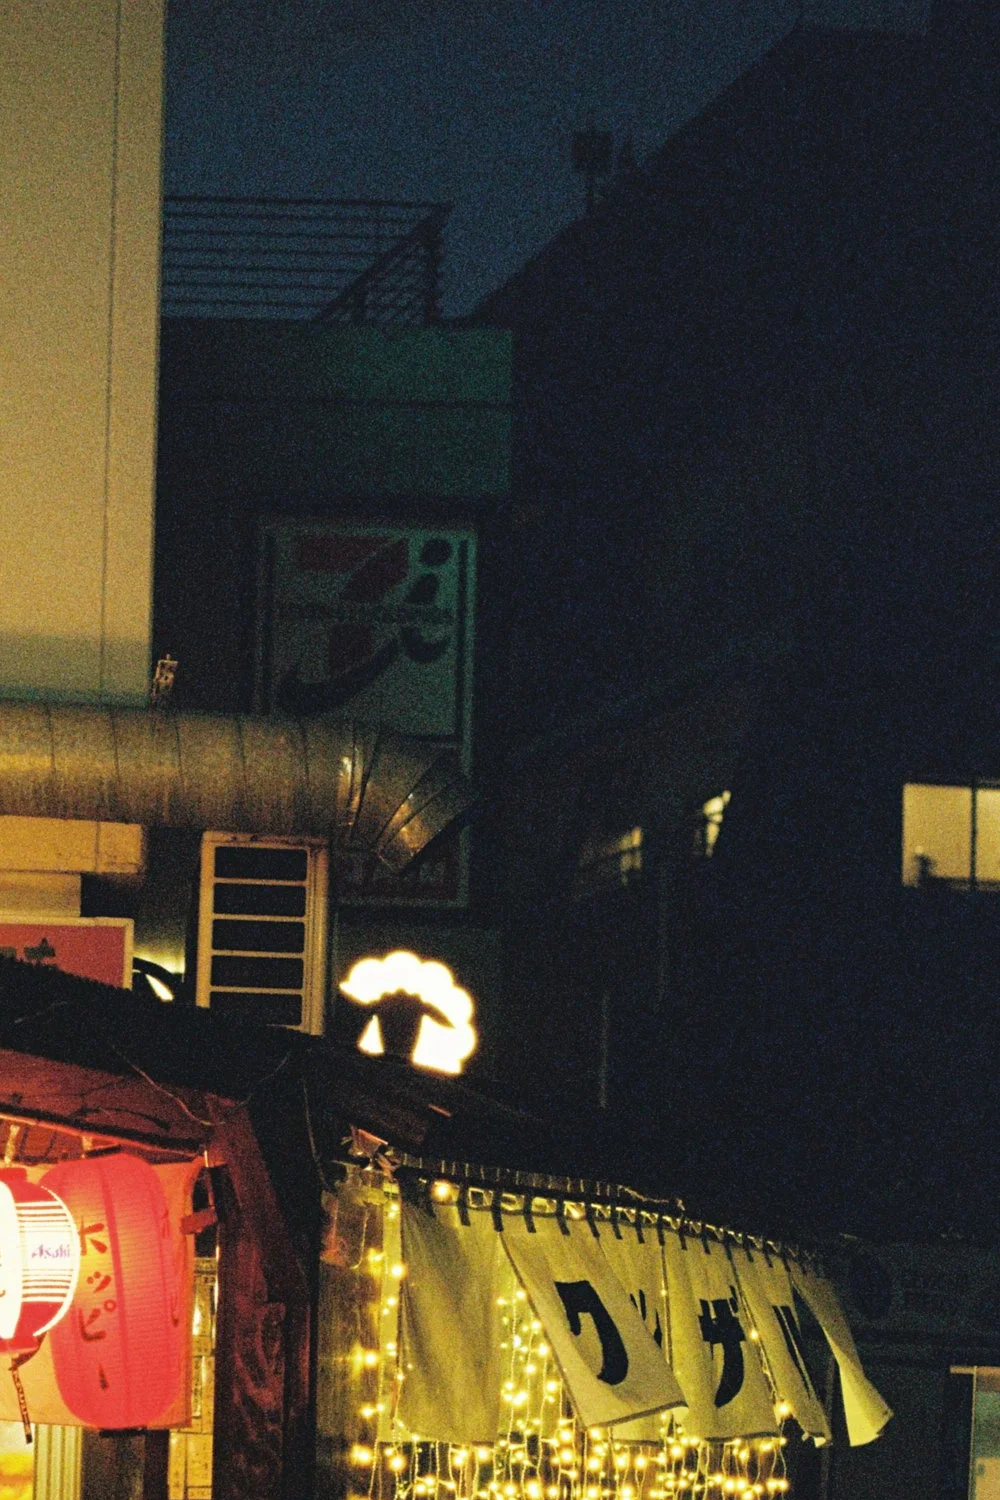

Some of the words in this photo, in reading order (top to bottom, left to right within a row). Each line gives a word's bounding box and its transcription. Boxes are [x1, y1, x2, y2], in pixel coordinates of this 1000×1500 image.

[30, 1242, 72, 1260] Asahi
[77, 1215, 117, 1390] ホッピー
